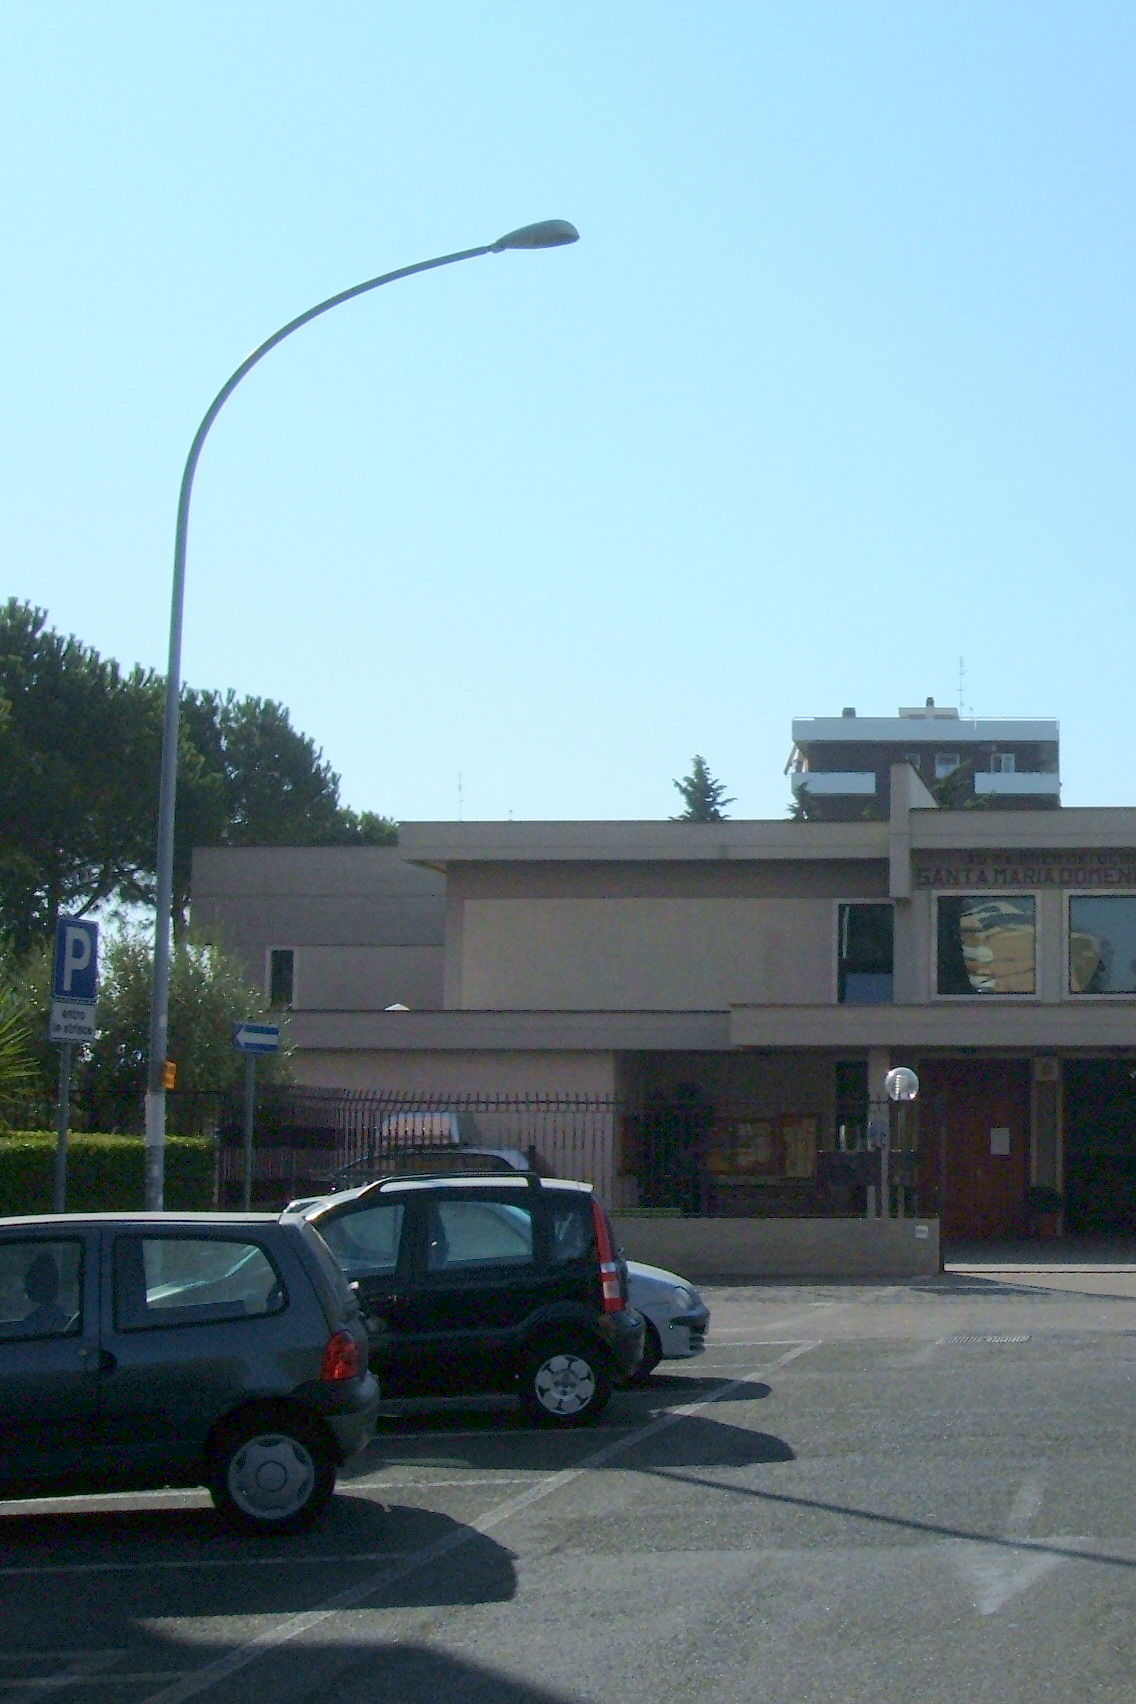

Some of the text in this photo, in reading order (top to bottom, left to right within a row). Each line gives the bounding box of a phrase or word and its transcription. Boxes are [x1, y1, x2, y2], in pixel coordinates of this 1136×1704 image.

[917, 867, 988, 886] SANTA
[993, 867, 1056, 886] MARIA
[63, 926, 91, 991] P
